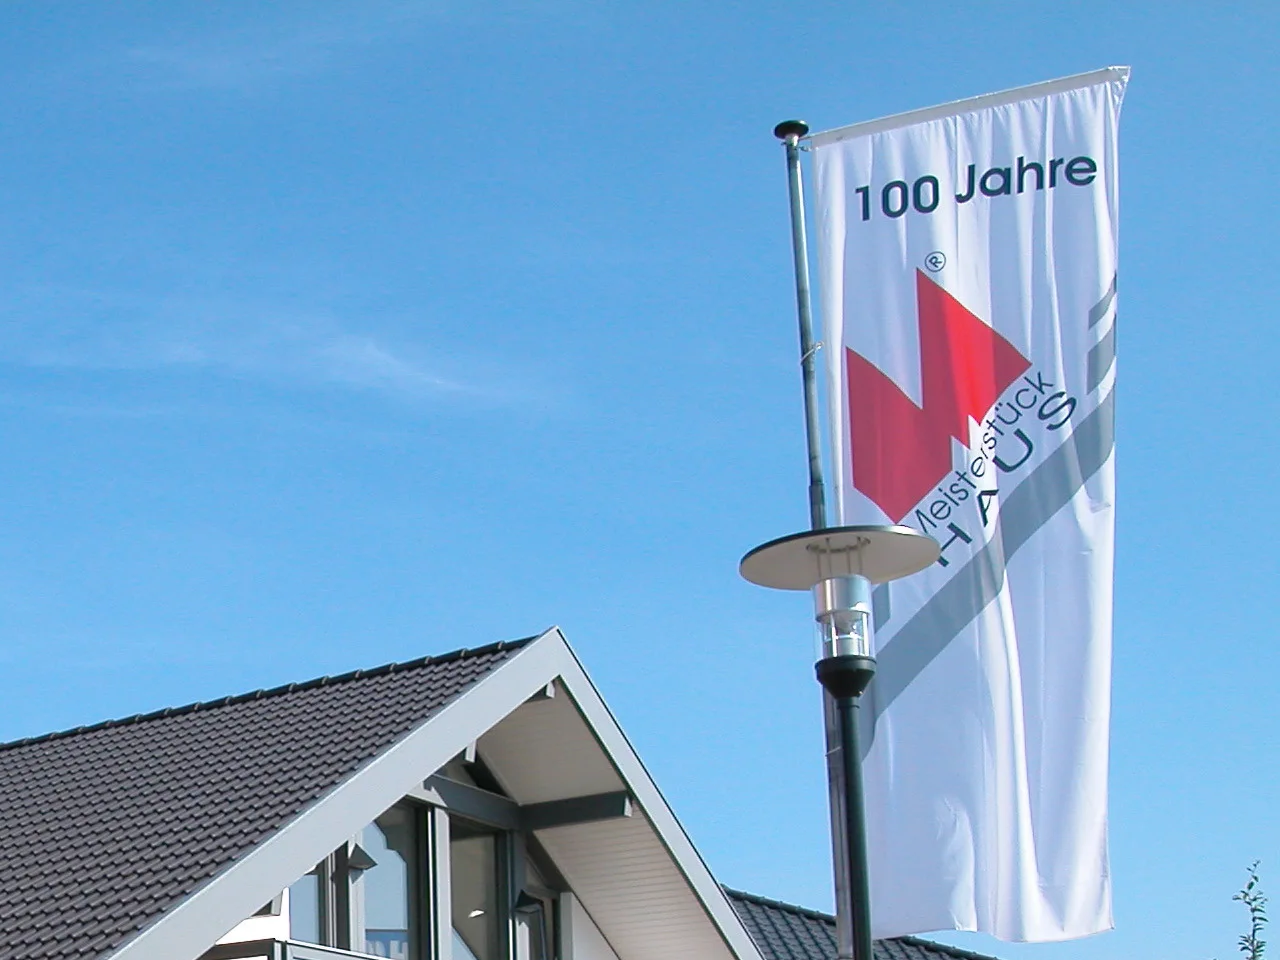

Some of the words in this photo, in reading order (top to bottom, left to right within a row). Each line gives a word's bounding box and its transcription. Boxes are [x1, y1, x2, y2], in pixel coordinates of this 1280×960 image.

[854, 174, 940, 222] 100
[955, 155, 1098, 204] Jahre
[936, 391, 1078, 568] HAUS
